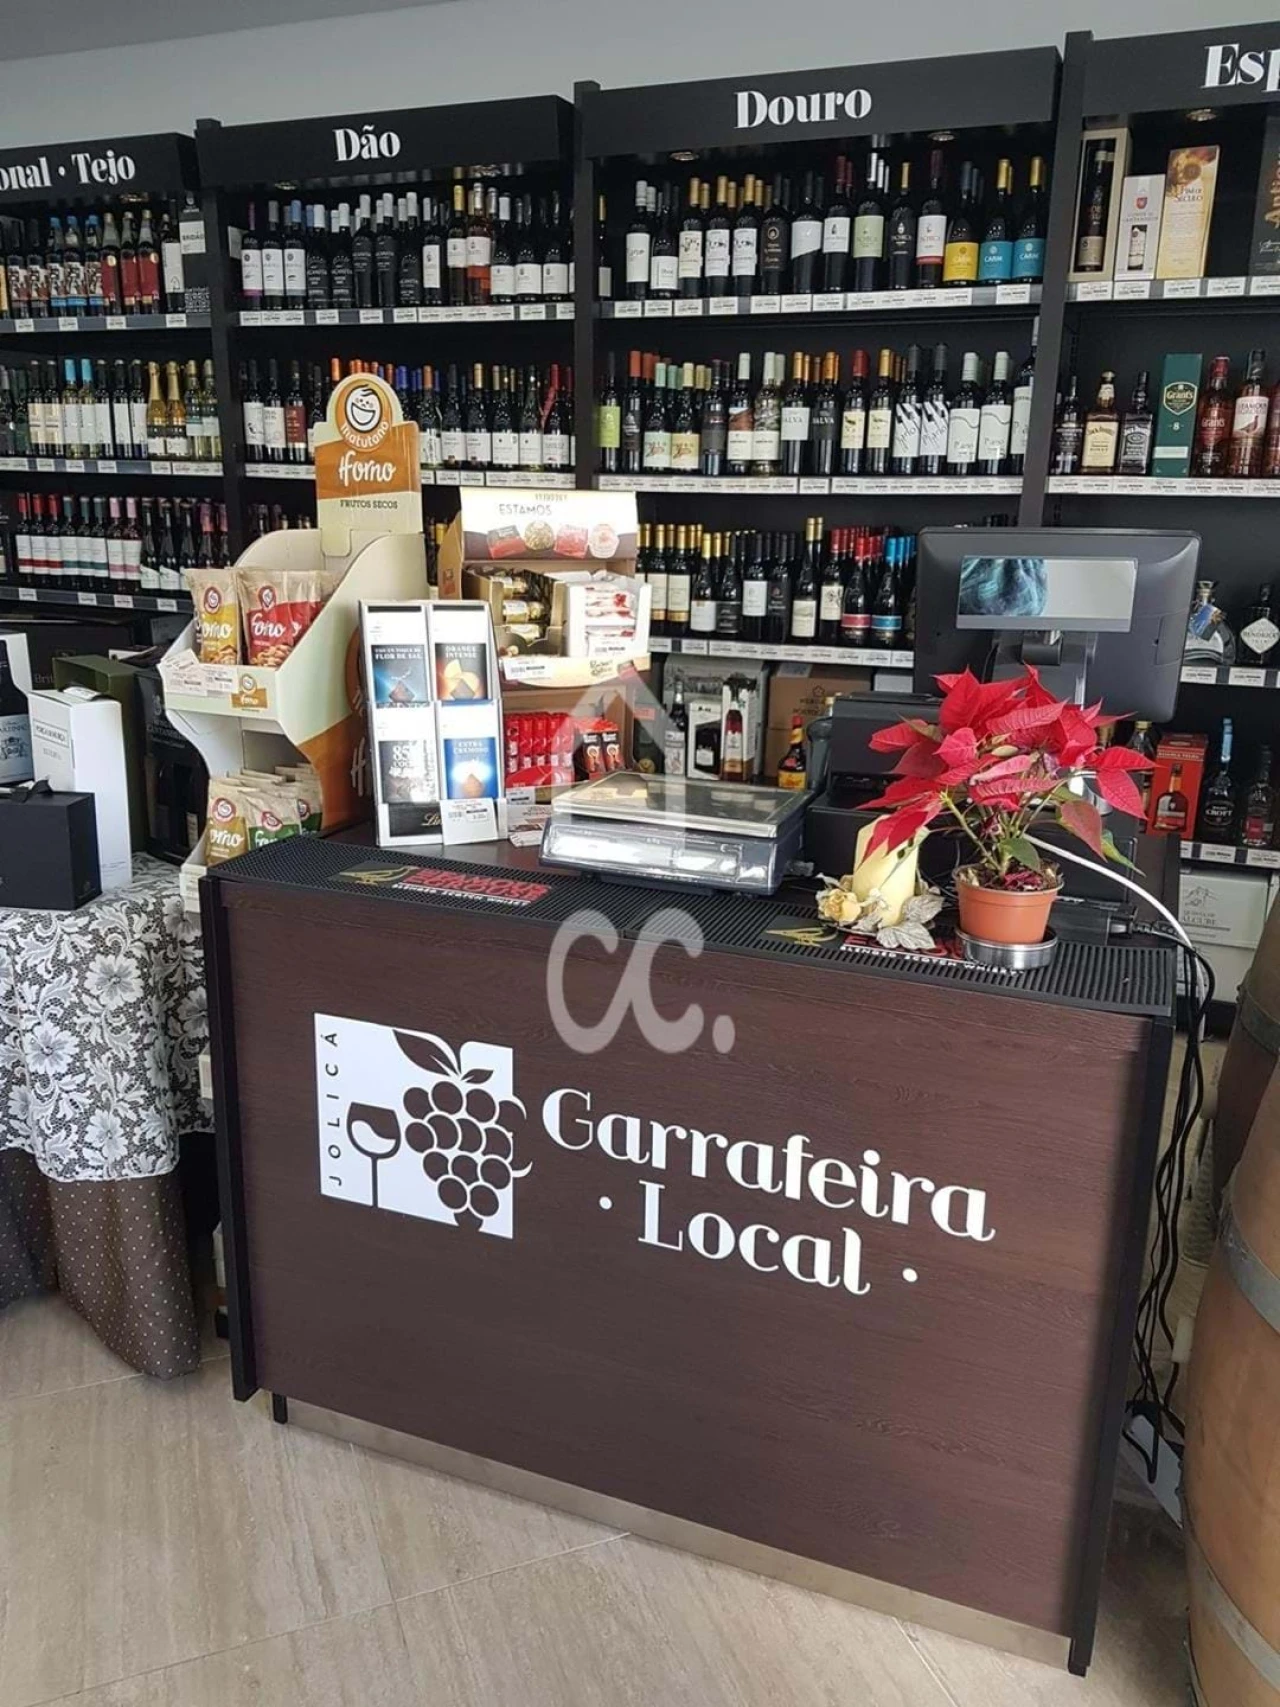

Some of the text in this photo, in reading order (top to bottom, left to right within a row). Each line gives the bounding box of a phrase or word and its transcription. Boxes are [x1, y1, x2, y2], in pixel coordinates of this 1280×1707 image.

[733, 88, 872, 129] Douro
[332, 124, 401, 162] Dão
[71, 149, 136, 186] Tejo
[1166, 389, 1195, 399] Grant's
[1172, 421, 1180, 430] 8
[1201, 416, 1226, 428] Grant's
[340, 499, 399, 510] FRUTOS SECOS
[498, 503, 552, 517] ESTAMOS
[1205, 809, 1233, 817] CROFT
[839, 945, 897, 959] BLENDED
[904, 954, 957, 968] SCOTCH
[541, 1087, 997, 1243] Garrafeira
[637, 1179, 871, 1296] Local
